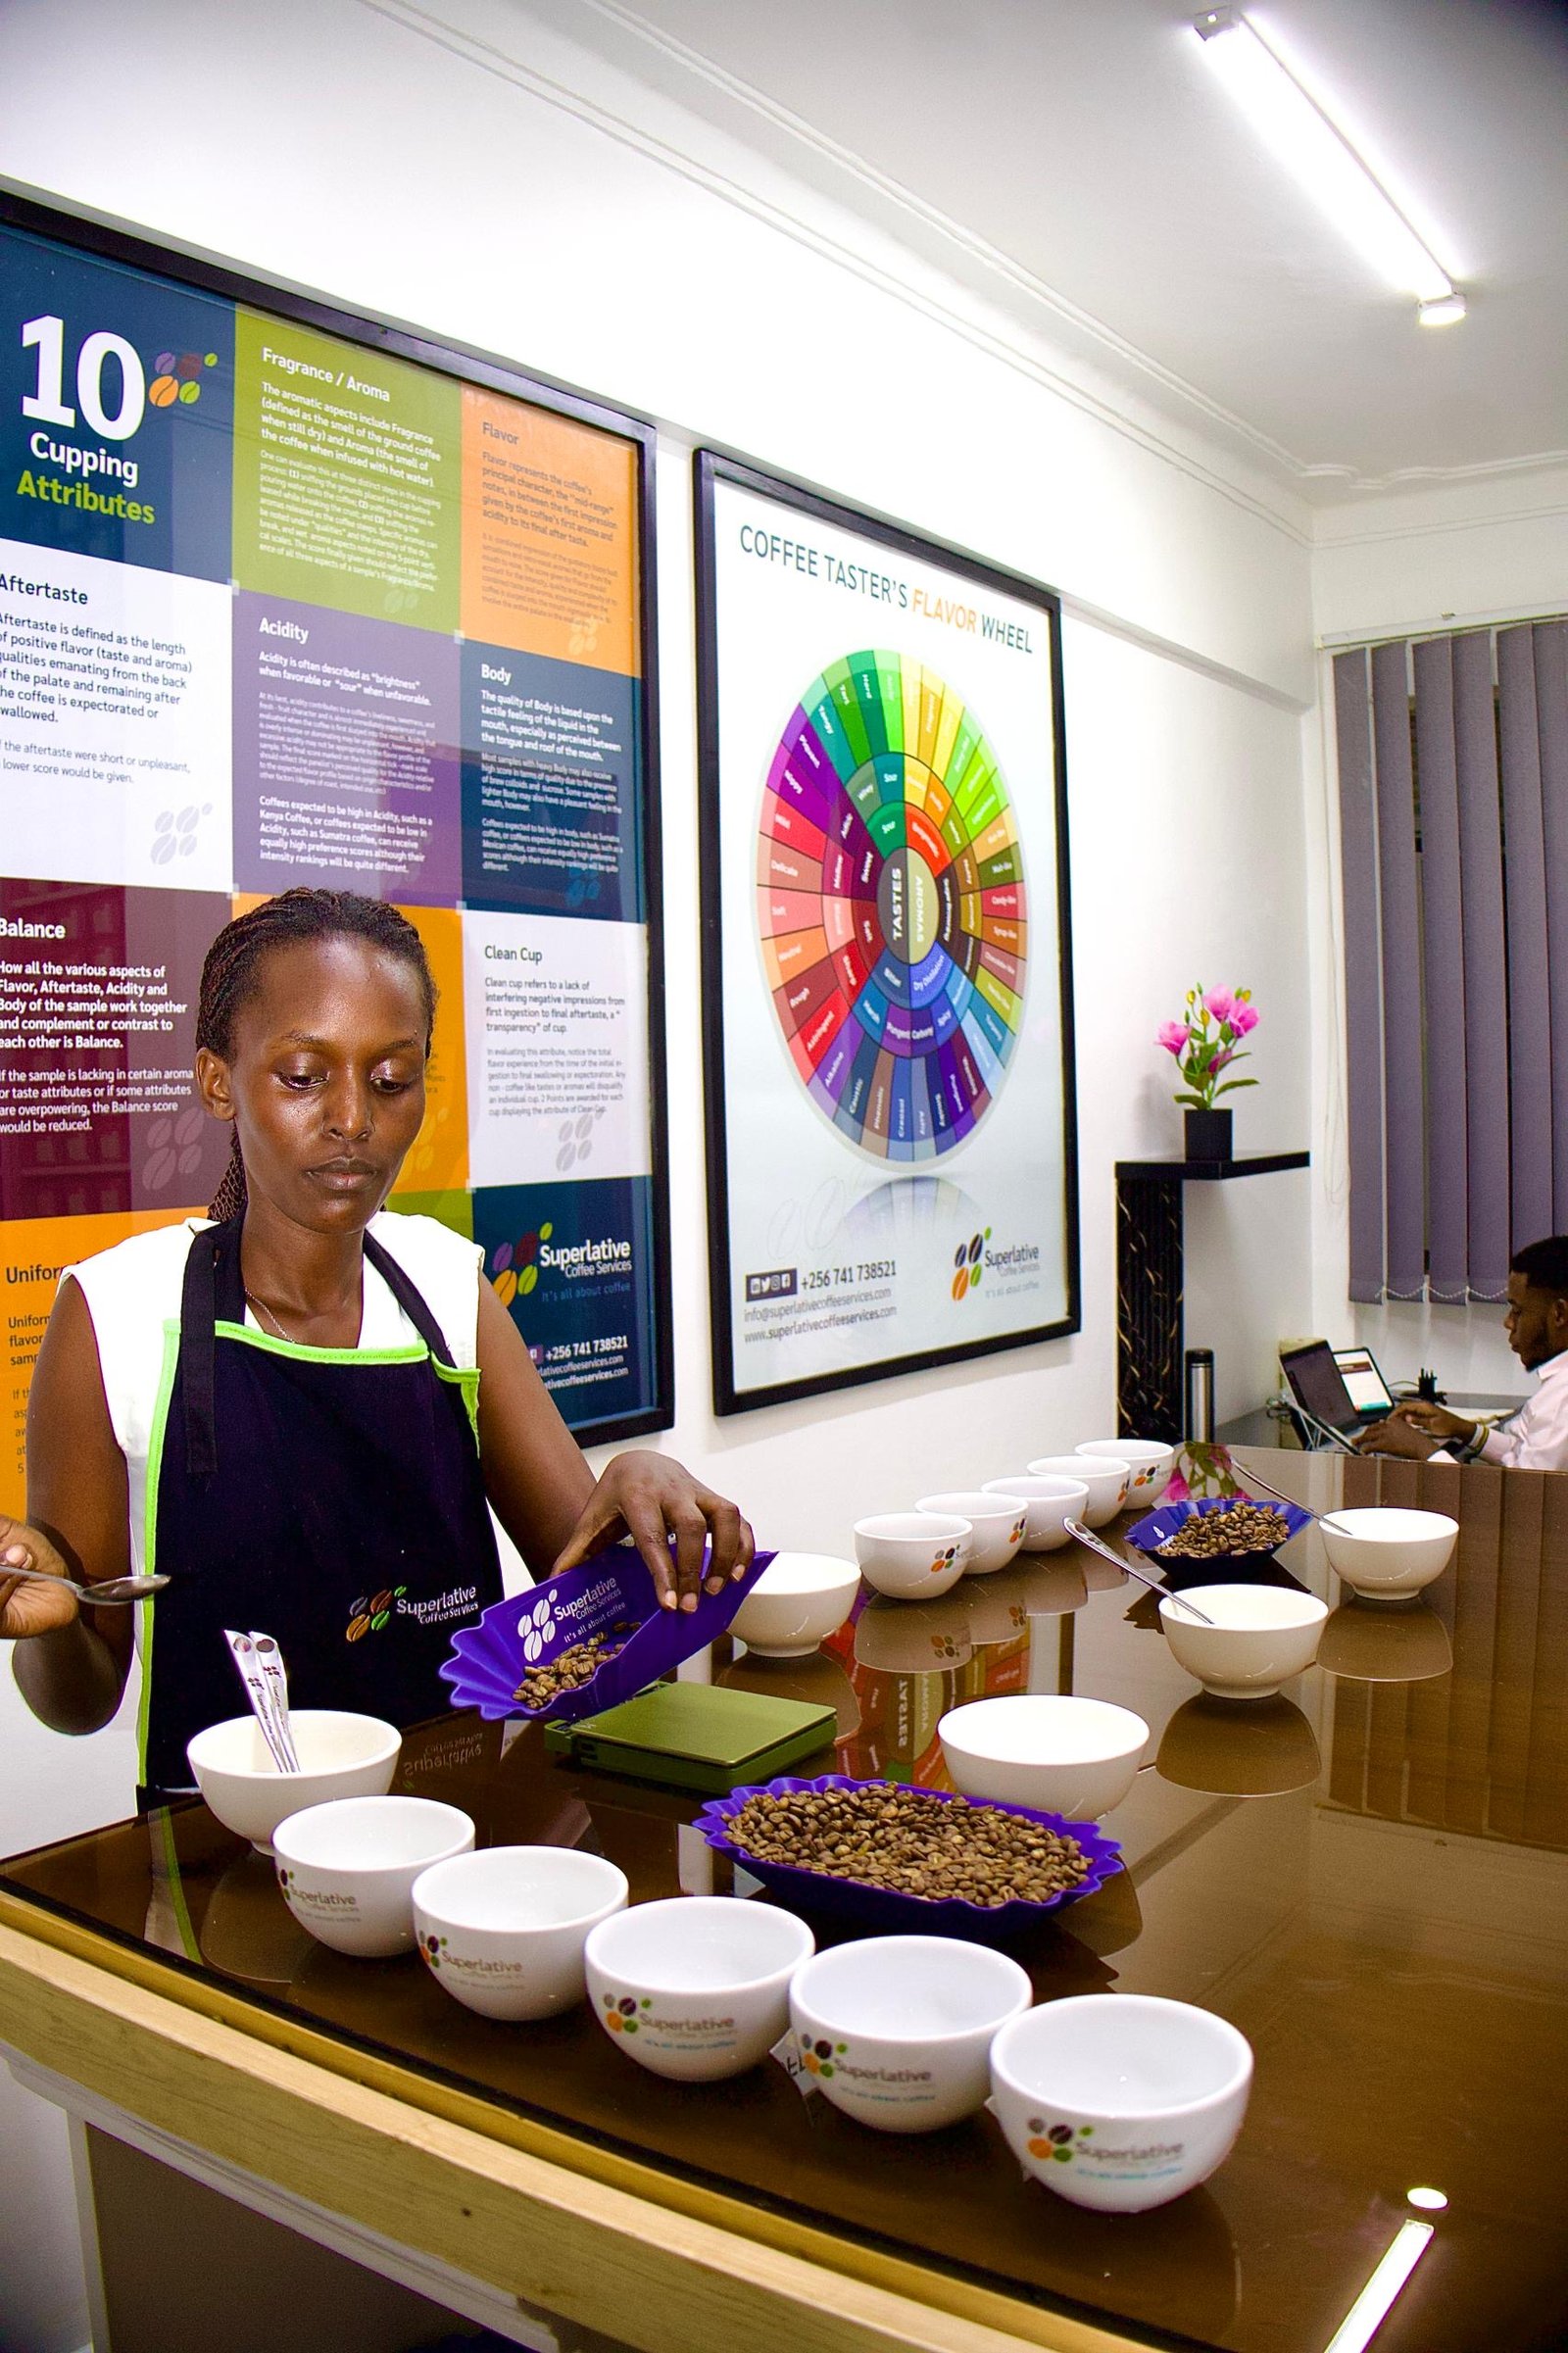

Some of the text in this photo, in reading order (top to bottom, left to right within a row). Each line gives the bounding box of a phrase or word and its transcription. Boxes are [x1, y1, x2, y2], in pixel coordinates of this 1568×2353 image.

[22, 315, 145, 441] 10
[263, 347, 390, 403] Fragrance / Aroma
[262, 381, 434, 445] The aromatic aspects include Fragrance
[482, 421, 519, 445] Flavor
[30, 432, 138, 488] Cupping
[17, 469, 155, 524] Attributes
[0, 573, 88, 605] Aftertaste
[740, 525, 1033, 654] COFFEE TASTER'S FLAVOR WHEEL
[59, 622, 70, 635] is
[71, 625, 114, 643] defined
[116, 635, 128, 646] as
[130, 635, 150, 649] the
[151, 637, 186, 656] length
[259, 617, 309, 645] Acidity
[10, 635, 192, 674] positive flavor (taste and aroma)
[10, 668, 180, 706] the palate and remaining after
[48, 659, 110, 680] emanating
[112, 666, 139, 682] from
[140, 670, 160, 685] the
[162, 673, 186, 690] back
[481, 663, 512, 685] Body
[0, 685, 159, 719] he coffee is expectorated or
[0, 706, 59, 723] wallowed.
[892, 868, 903, 942] TASTES
[0, 918, 66, 939] Balance
[24, 961, 41, 975] all
[42, 961, 64, 975] the
[65, 962, 108, 977] various
[109, 965, 152, 980] aspects
[153, 965, 166, 978] of
[484, 945, 543, 965] Clean Cup
[39, 980, 104, 997] Aftertaste,
[106, 981, 145, 998] Acidity
[146, 982, 168, 996] and
[28, 998, 43, 1011] of
[44, 998, 66, 1012] the
[67, 999, 108, 1015] sample
[109, 1000, 137, 1012] work
[139, 1000, 187, 1016] together
[21, 1016, 95, 1033] complement
[96, 1020, 111, 1031] or
[111, 1018, 159, 1031] contrast
[160, 1018, 173, 1031] to
[27, 1035, 62, 1049] other
[63, 1035, 74, 1049] is
[75, 1035, 123, 1049] Balance.
[824, 1052, 844, 1088] Alkaline
[849, 1077, 864, 1114] Caustic
[540, 1238, 631, 1270] Superlative
[565, 1258, 632, 1278] Coffee Services
[985, 1243, 1039, 1270] Superlative
[6, 1264, 61, 1284] Unifor
[802, 1260, 897, 1291] +256 741 738521
[744, 1305, 898, 1344] www.superlativecoffeeservices.com
[545, 1335, 628, 1361] +256 741 738521
[396, 1586, 476, 1619] Superlative
[554, 1577, 616, 1621] Superlative
[575, 1588, 621, 1620] Coffee Services
[564, 1601, 626, 1643] It's all about coffee
[290, 1884, 356, 1905] Superlative
[441, 1950, 522, 1972] Superlative
[639, 2013, 735, 2033] Superlative
[834, 2058, 932, 2083] Superlative
